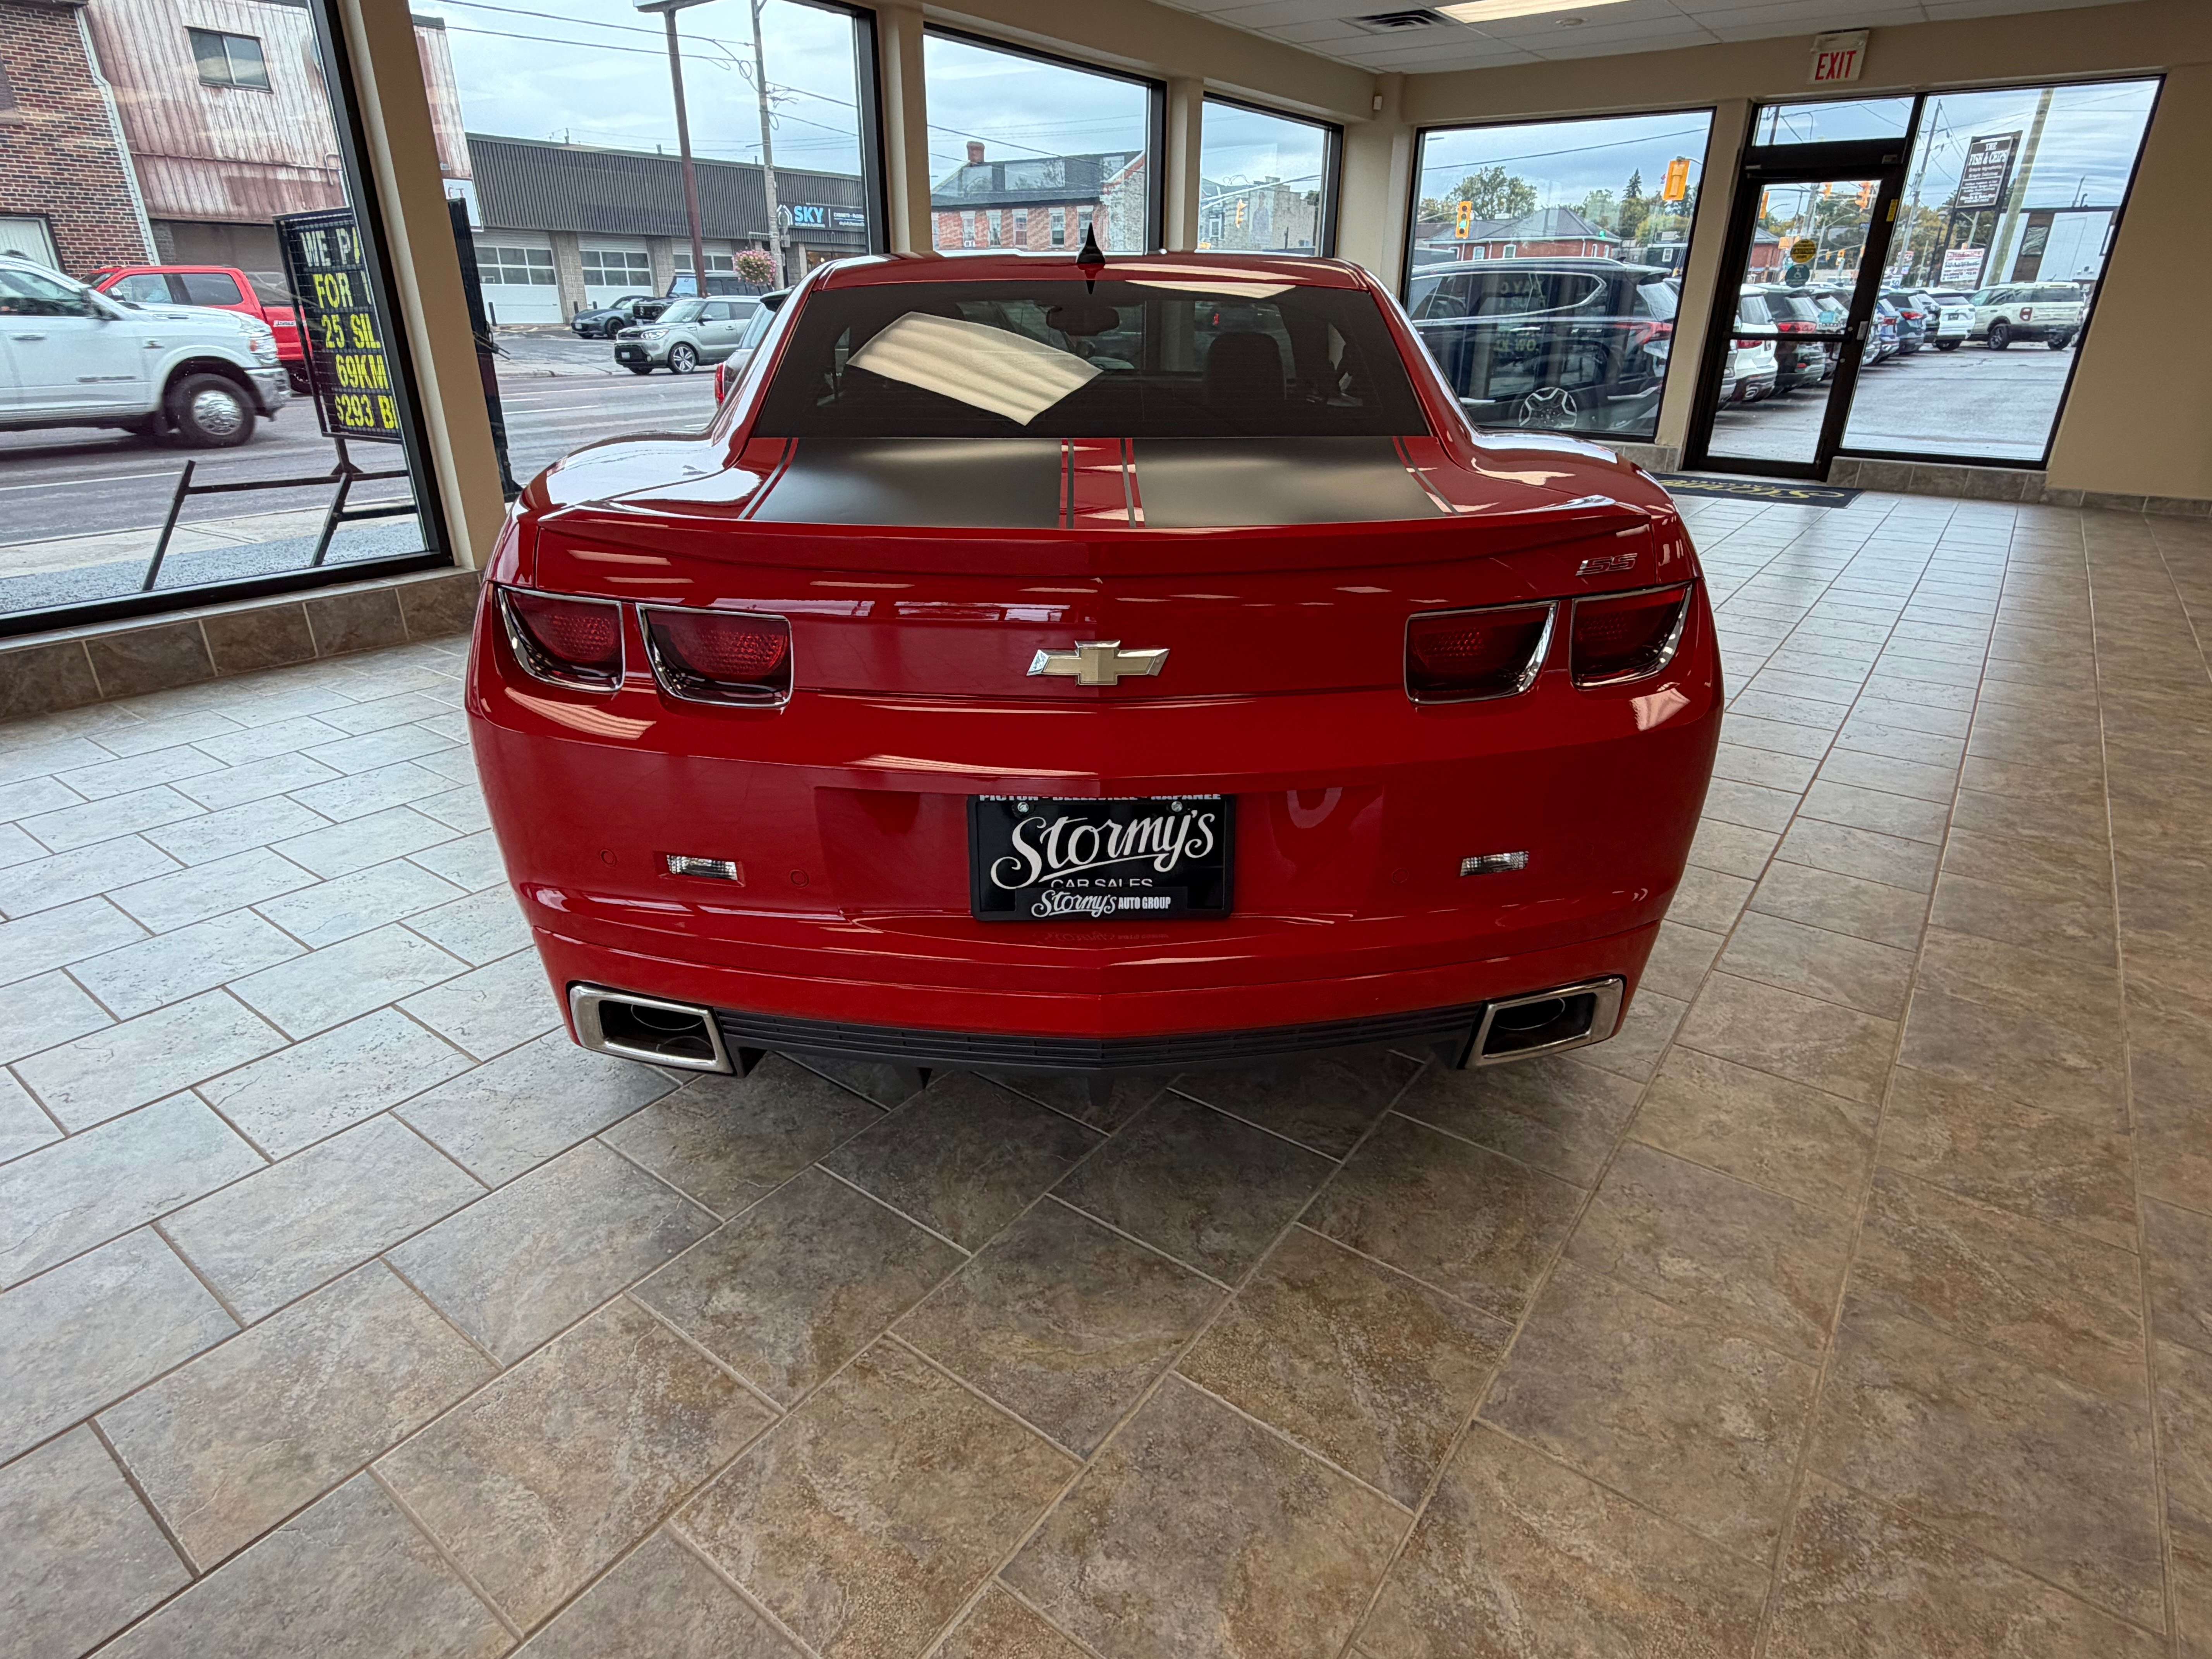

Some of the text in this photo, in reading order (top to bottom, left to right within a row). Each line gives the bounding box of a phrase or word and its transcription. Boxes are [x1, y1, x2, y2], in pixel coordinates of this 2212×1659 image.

[1815, 50, 1857, 81] EXIT
[1968, 153, 1984, 166] FISH
[794, 206, 824, 223] SKY
[299, 230, 331, 267] WE
[313, 273, 353, 309] FOR
[321, 314, 345, 348] 25
[335, 354, 389, 389] 69KM
[335, 393, 374, 427] $293
[1575, 553, 1638, 576] SS
[991, 810, 1215, 890] Stormy's
[1051, 878, 1153, 888] CAR SALES
[1031, 890, 1171, 917] Stormy's AUTO GROUP
